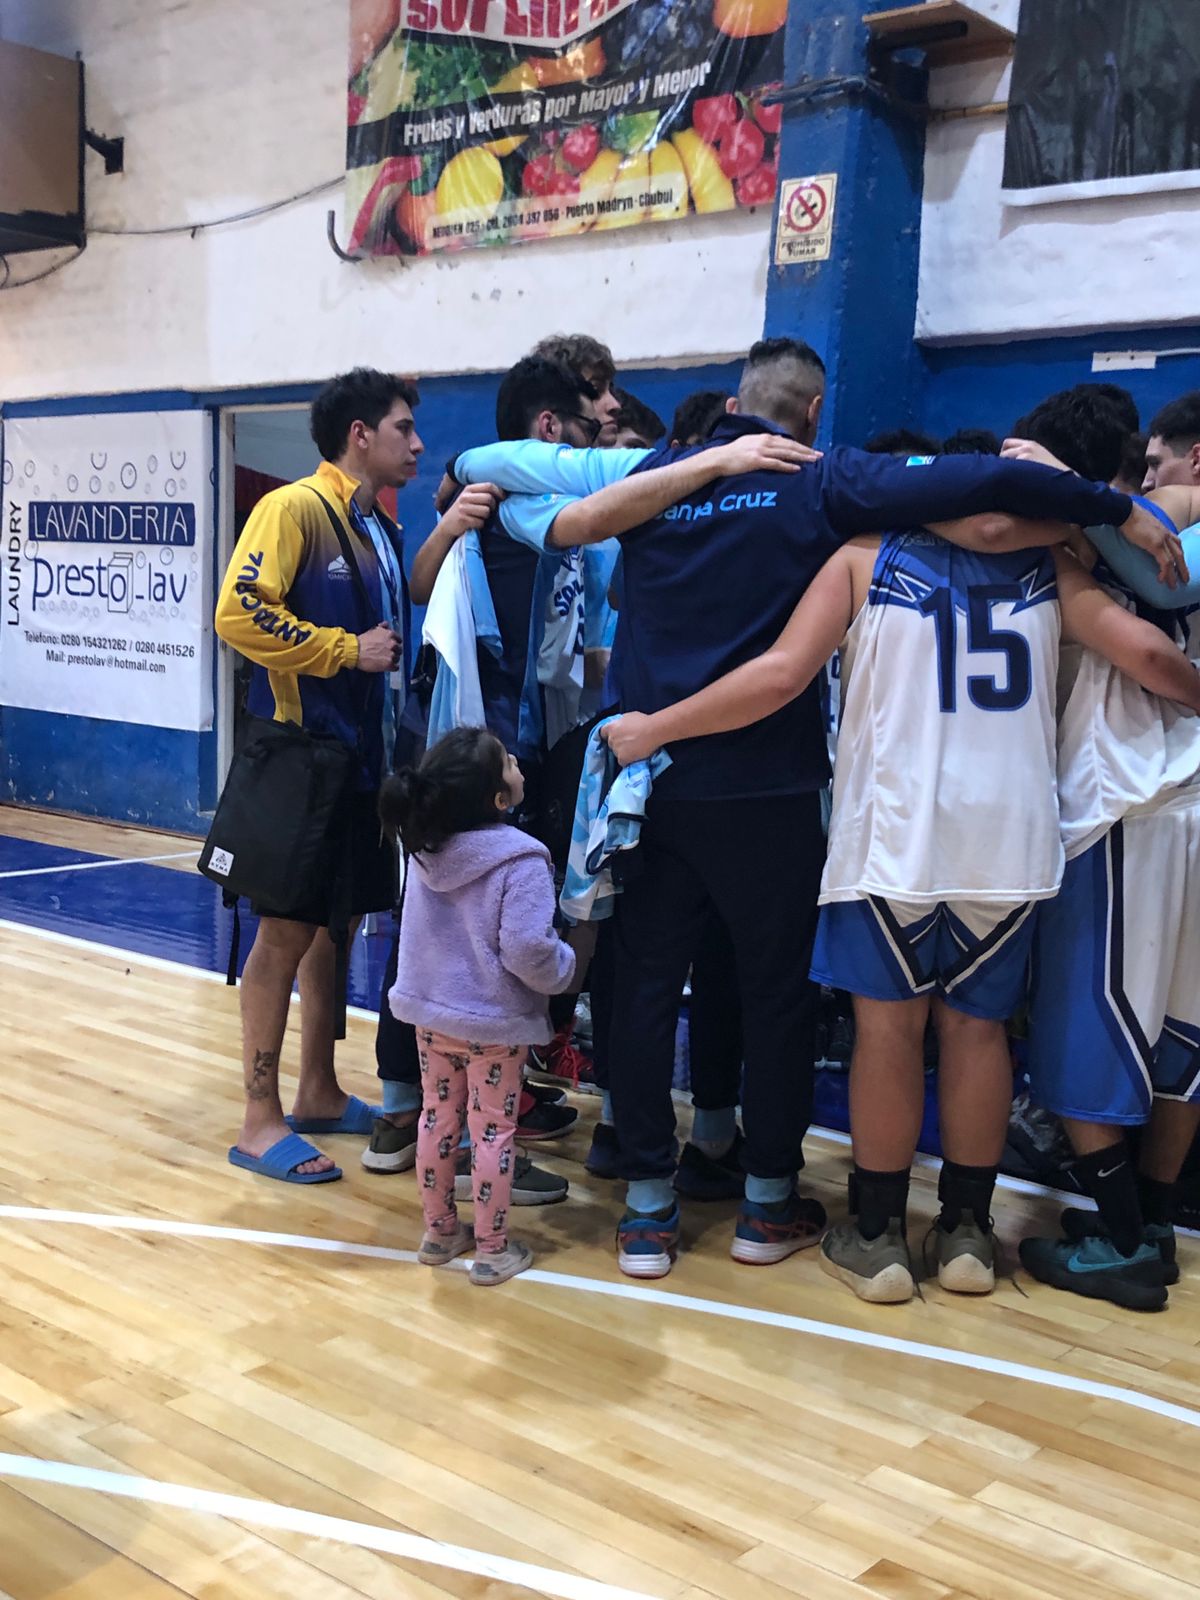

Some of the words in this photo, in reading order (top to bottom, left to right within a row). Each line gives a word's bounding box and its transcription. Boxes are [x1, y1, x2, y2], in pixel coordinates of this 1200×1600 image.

[404, 117, 452, 146] Frutas
[455, 115, 465, 139] y
[469, 100, 542, 134] Verduras
[544, 94, 577, 123] por
[578, 81, 635, 114] Mayor
[637, 77, 650, 104] y
[652, 61, 711, 98] Menor
[597, 196, 633, 214] Madryn
[33, 505, 189, 542] LAVANDERIA
[7, 501, 22, 626] LAUNDRY
[234, 550, 264, 611] CRUZ
[46, 649, 66, 662] Mail:
[67, 653, 166, 673] prestolav@hotmail.com
[61, 635, 81, 647] 0280
[82, 636, 127, 651] 154321262
[135, 641, 156, 654] 0280
[157, 643, 195, 658] 4451526
[917, 584, 1032, 714] 15
